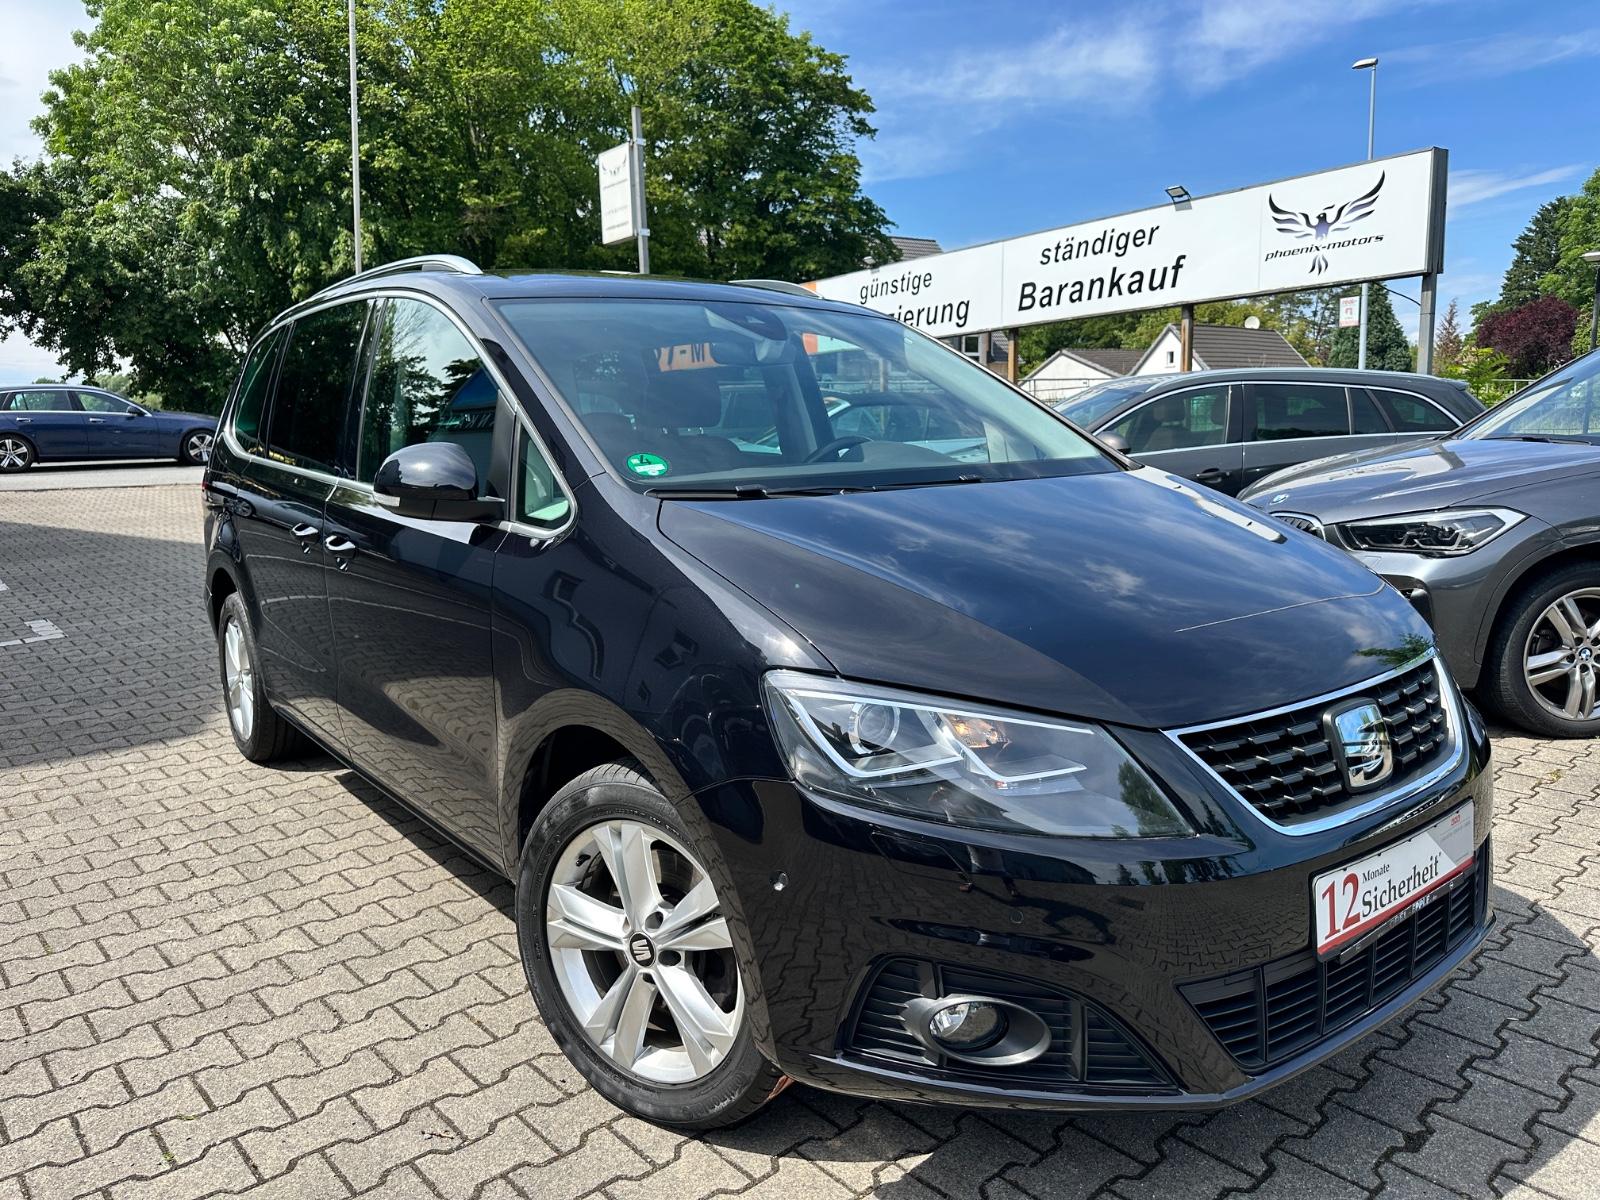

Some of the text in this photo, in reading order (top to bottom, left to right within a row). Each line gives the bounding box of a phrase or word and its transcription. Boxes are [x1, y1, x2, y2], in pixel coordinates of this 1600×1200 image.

[1039, 225, 1160, 266] ständiger
[1264, 234, 1385, 262] phoenix-motors
[859, 270, 933, 305] günstige
[1017, 254, 1187, 312] Barankauf
[888, 299, 970, 328] ierung
[1361, 862, 1391, 884] Monate
[1321, 872, 1361, 941] 12
